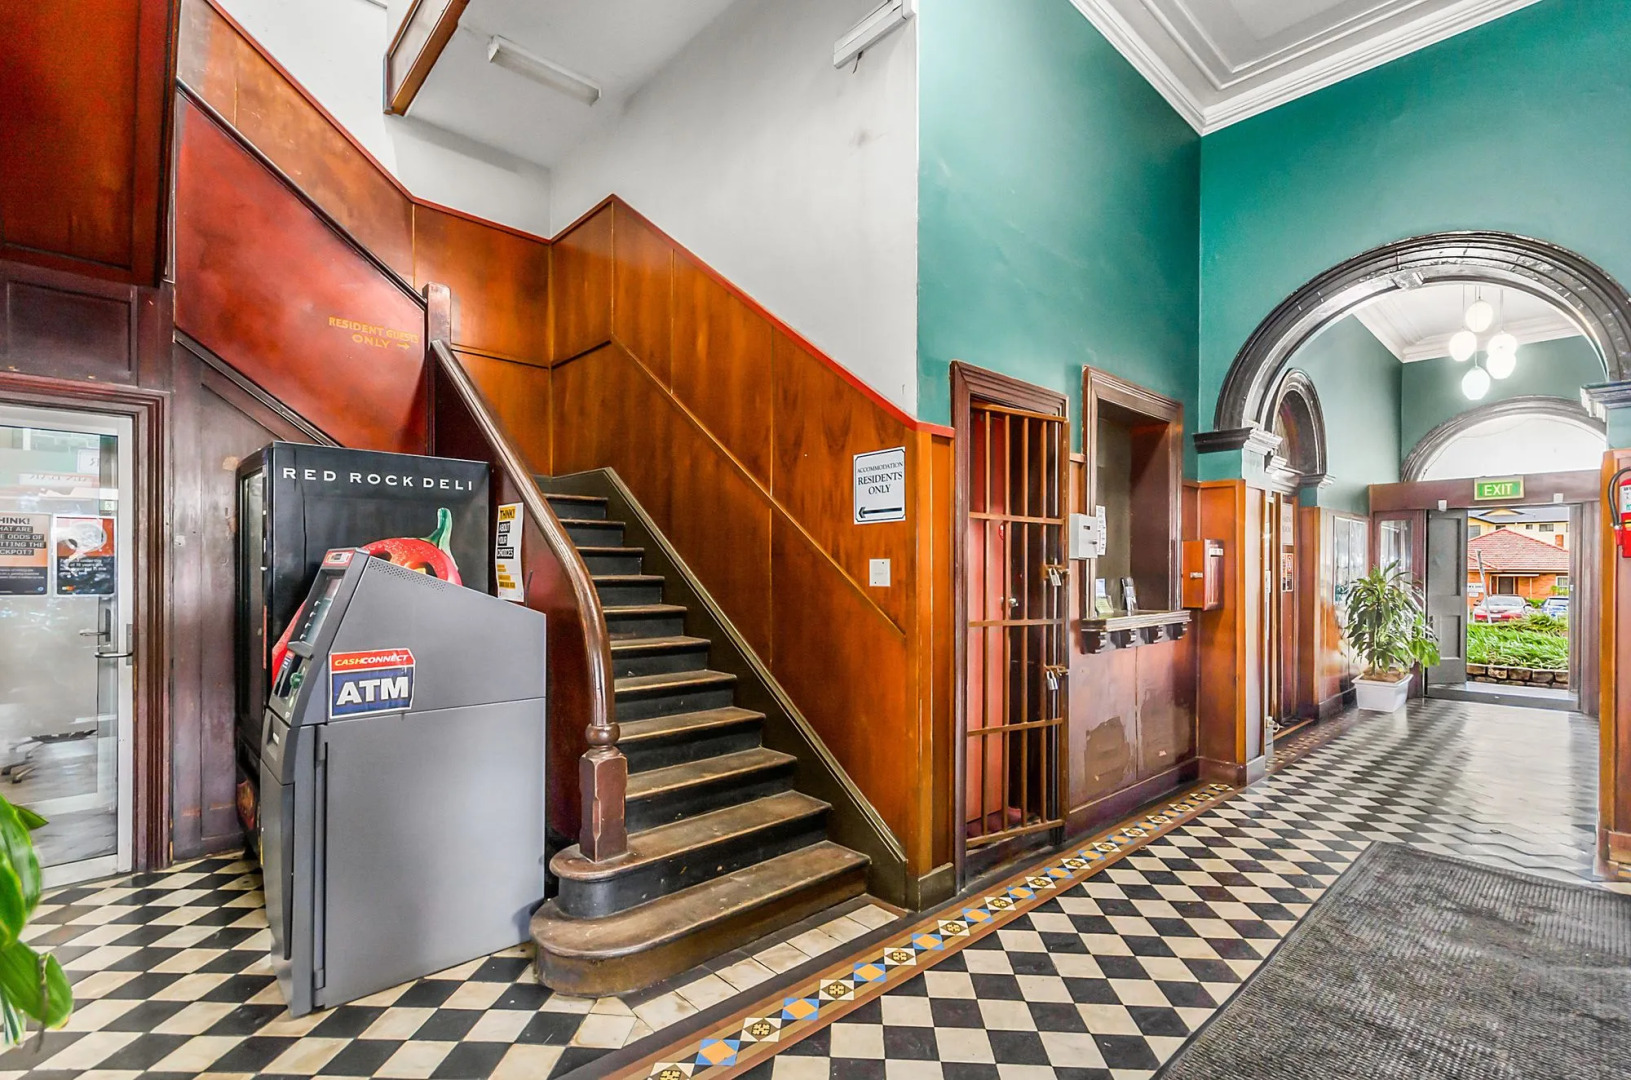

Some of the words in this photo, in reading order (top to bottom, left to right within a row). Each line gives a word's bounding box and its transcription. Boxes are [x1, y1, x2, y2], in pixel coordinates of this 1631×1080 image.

[329, 317, 384, 335] RESIDENT
[386, 329, 418, 344] GUESTS
[351, 333, 390, 349] ONLY
[858, 462, 903, 473] ACCOMMODATION
[282, 467, 337, 482] RED
[350, 472, 414, 487] ROCK
[423, 477, 473, 491] DELI
[858, 472, 903, 485] RESIDENTS
[868, 484, 891, 495] ONLY
[1484, 483, 1513, 496] EXIT
[335, 654, 408, 666] CASHCONNECT
[336, 676, 409, 705] ATM
